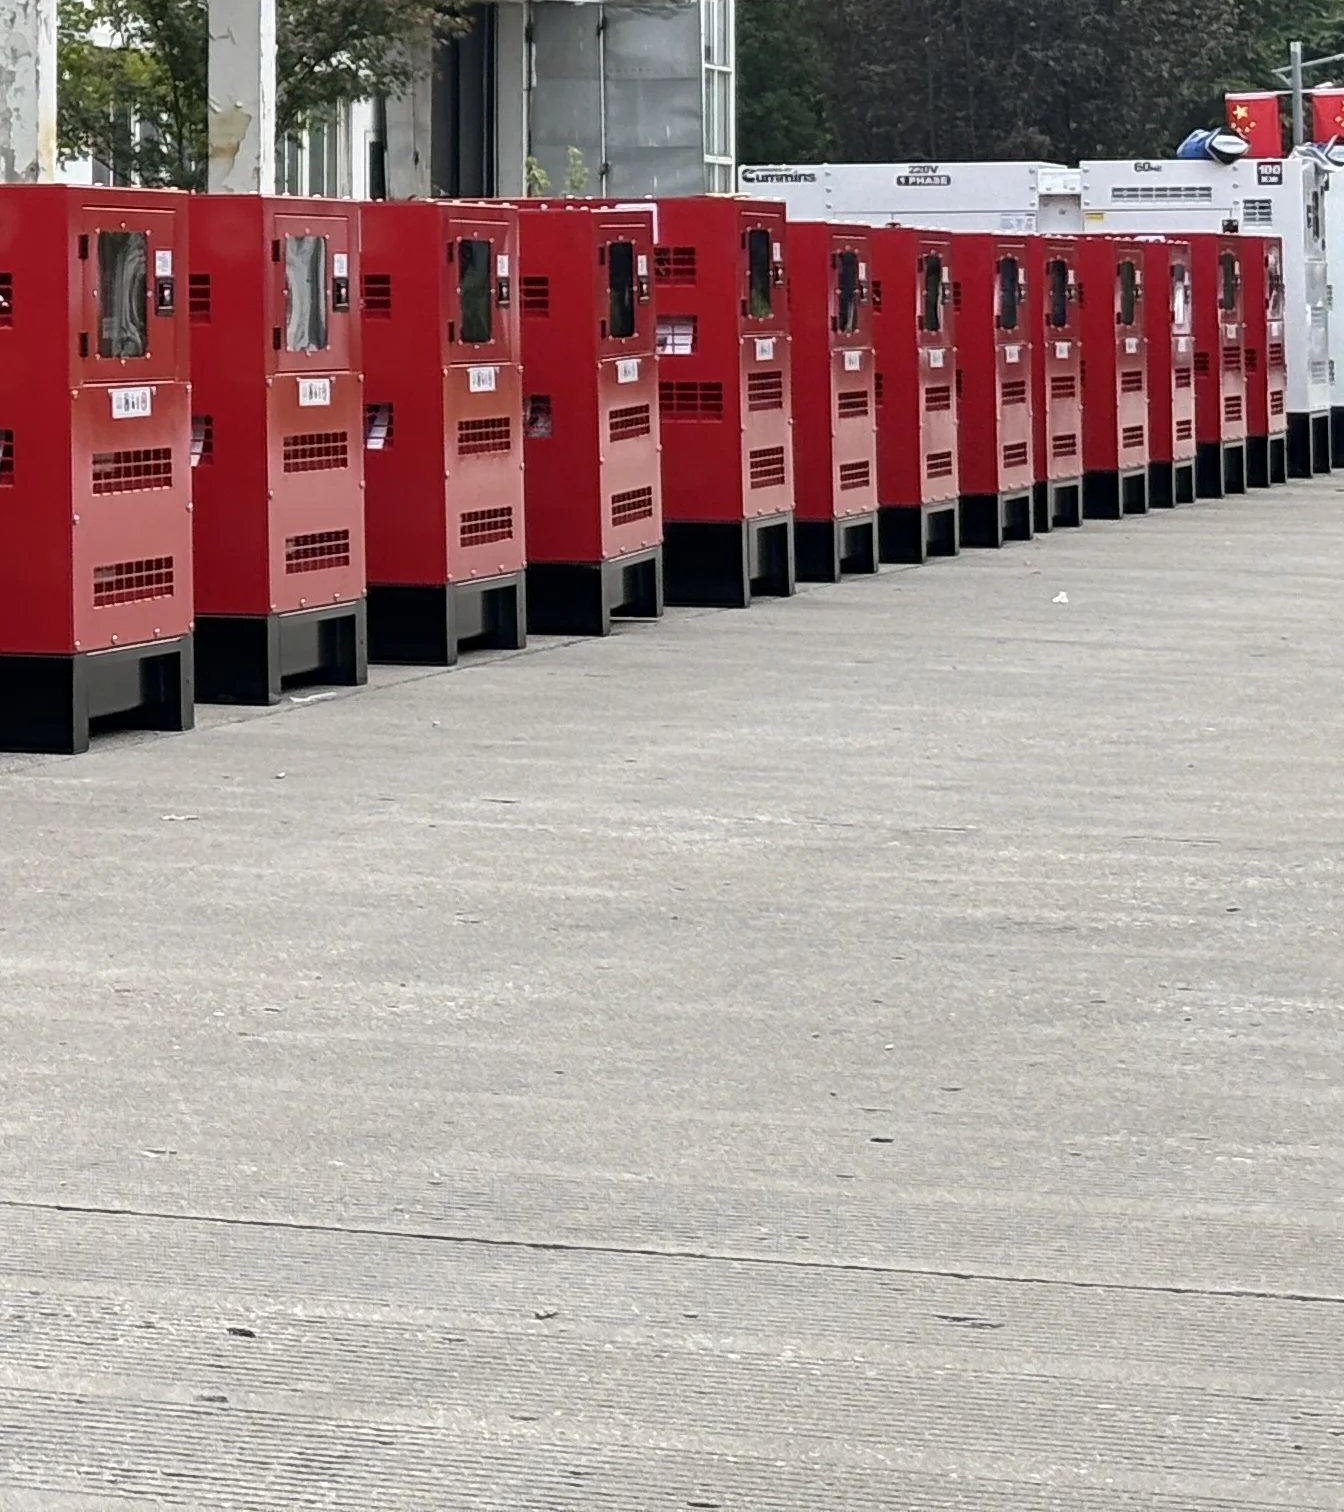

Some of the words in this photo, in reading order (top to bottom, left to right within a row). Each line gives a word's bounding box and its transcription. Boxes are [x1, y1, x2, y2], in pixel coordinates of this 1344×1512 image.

[908, 165, 939, 174] 220V
[1258, 164, 1281, 175] 100
[741, 168, 817, 183] Cummins
[908, 176, 948, 185] PHASE
